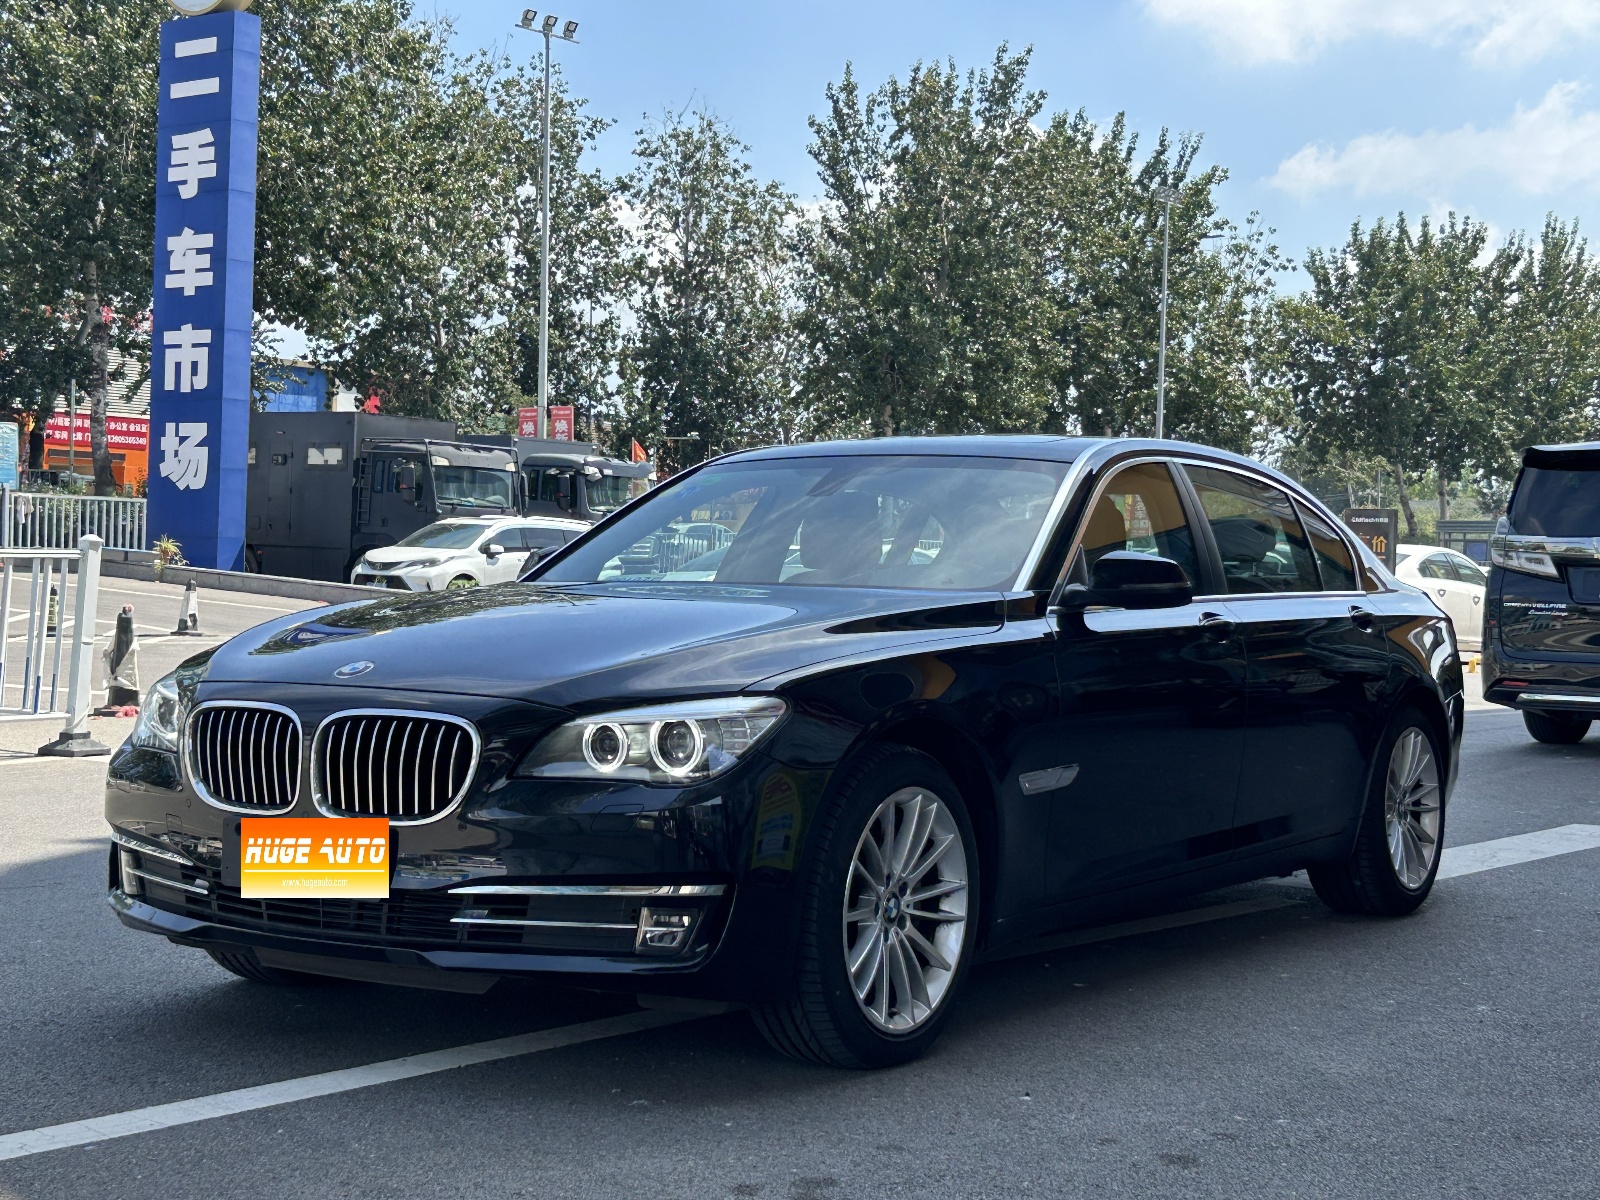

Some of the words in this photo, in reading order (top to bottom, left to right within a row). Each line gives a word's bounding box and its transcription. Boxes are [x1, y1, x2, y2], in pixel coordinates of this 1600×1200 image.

[159, 36, 220, 491] 二手车市场
